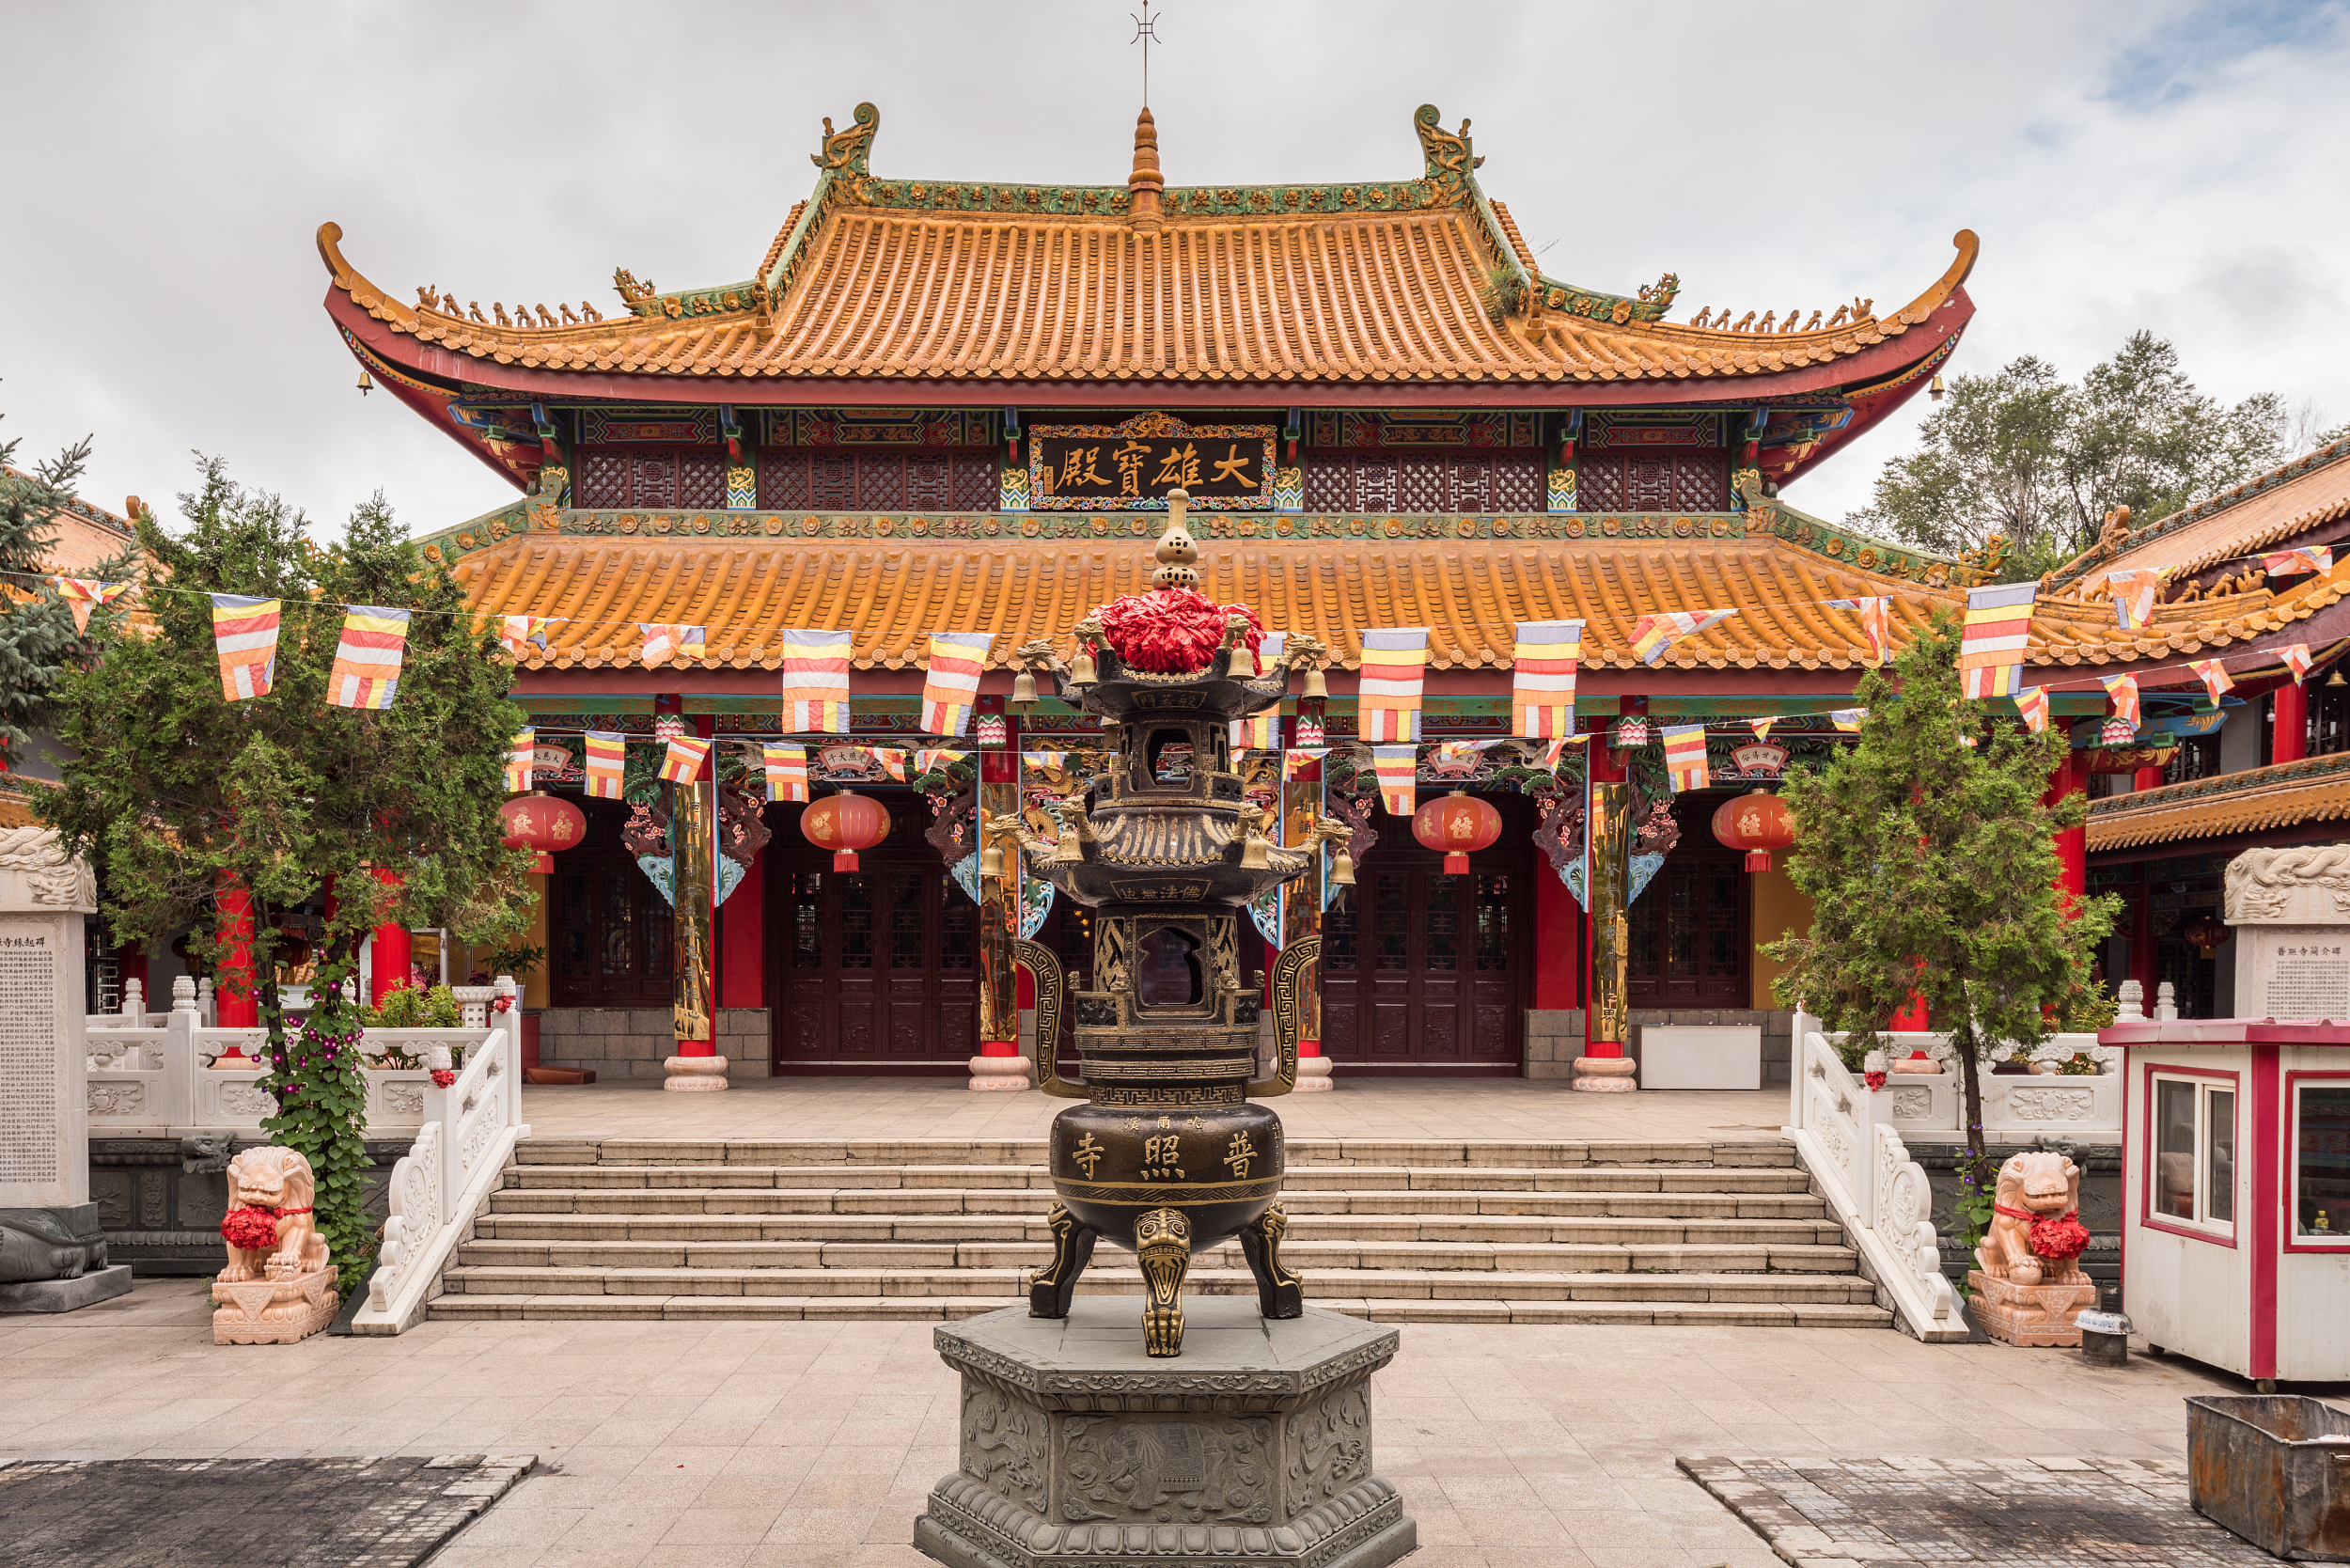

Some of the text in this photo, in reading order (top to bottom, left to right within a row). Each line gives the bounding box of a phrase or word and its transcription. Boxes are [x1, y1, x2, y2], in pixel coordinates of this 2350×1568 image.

[1055, 440, 1258, 496] 大雄寶殿
[533, 750, 560, 763] 大慈大
[1123, 1116, 1207, 1131] 哈爾濱
[1072, 1130, 1259, 1181] 普照寺
